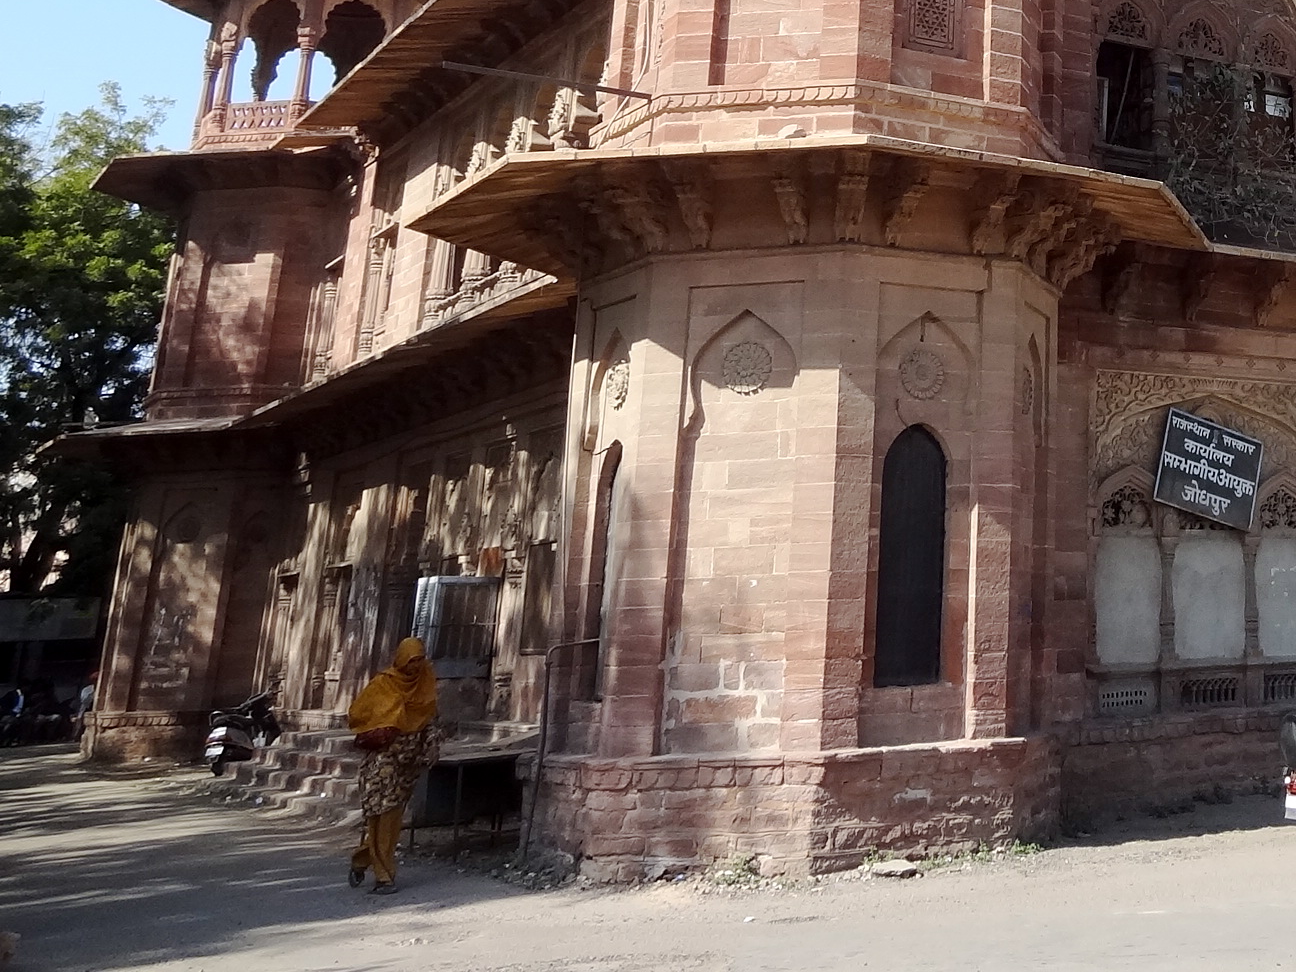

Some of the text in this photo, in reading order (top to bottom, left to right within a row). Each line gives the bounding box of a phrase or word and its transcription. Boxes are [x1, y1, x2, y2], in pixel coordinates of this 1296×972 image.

[1172, 415, 1256, 456] राजस्थान सरकार
[1184, 437, 1235, 467] कार्यालय
[1181, 479, 1231, 516] जोधपुर
